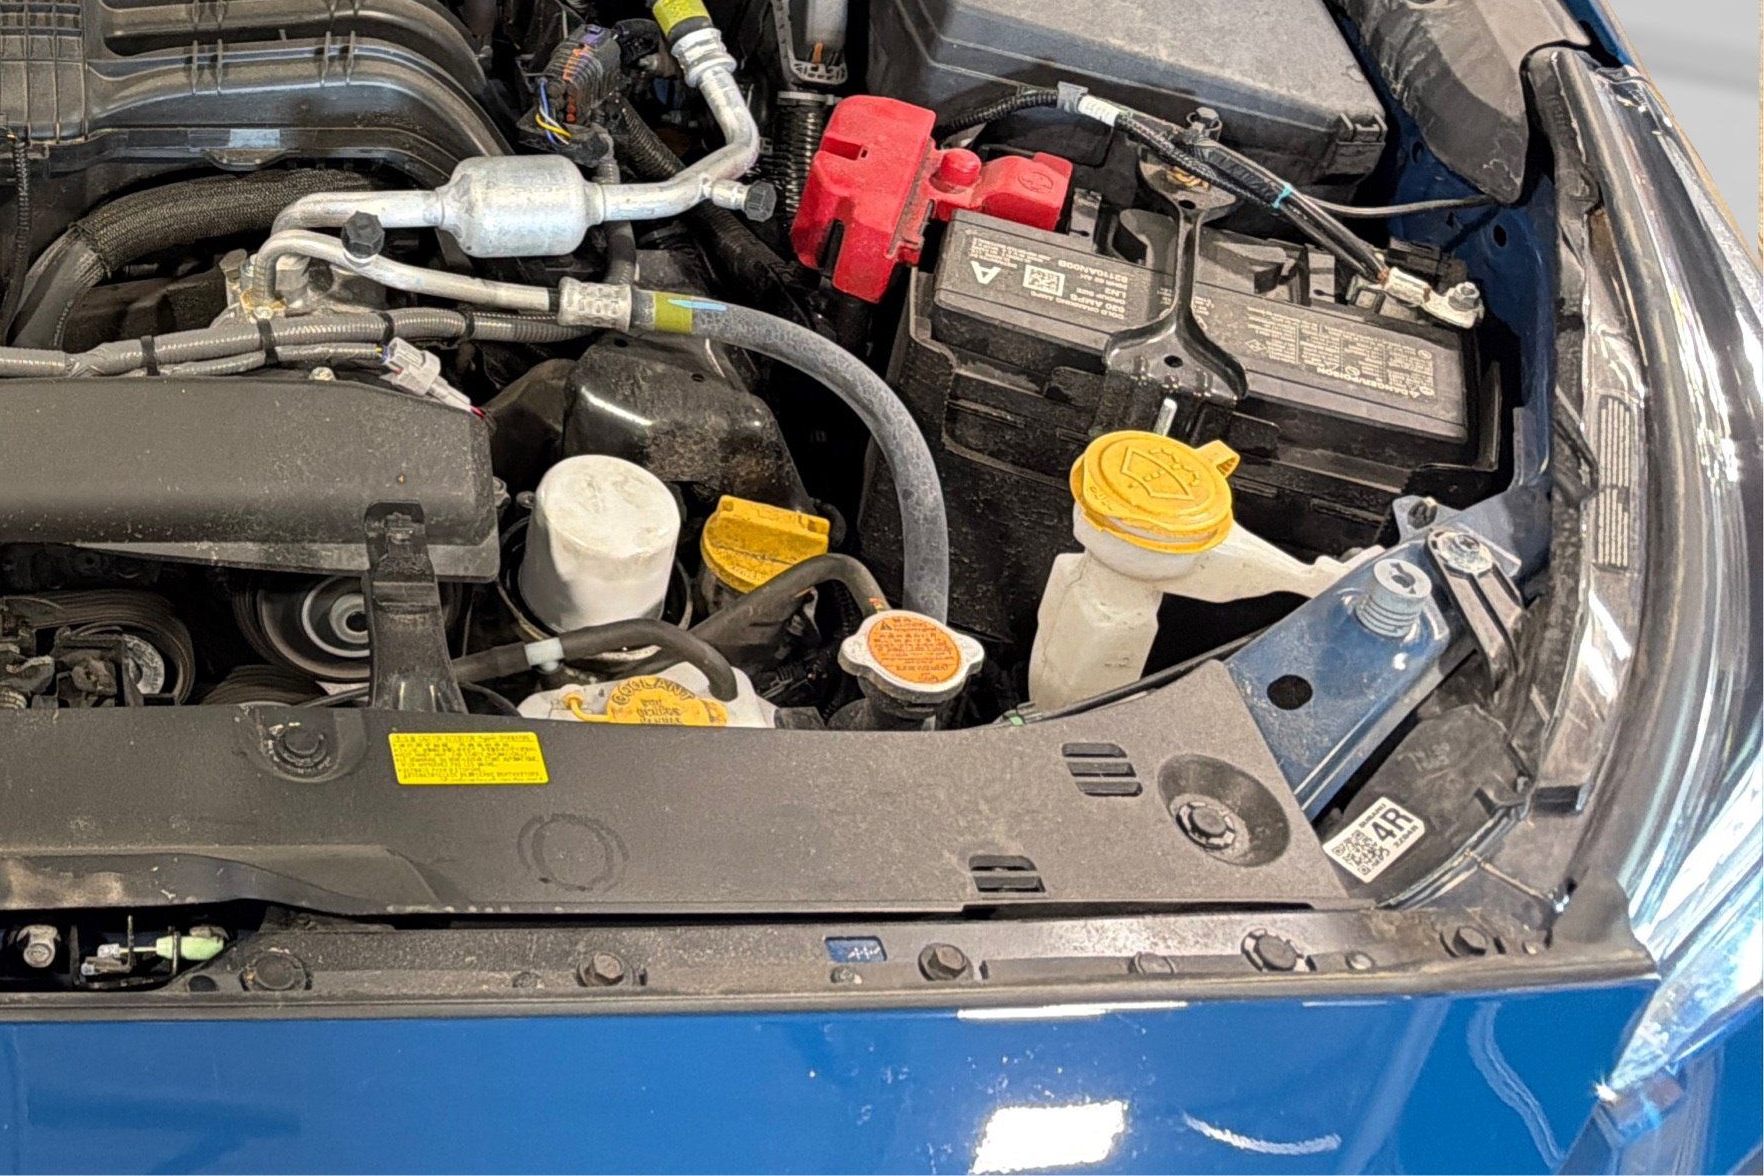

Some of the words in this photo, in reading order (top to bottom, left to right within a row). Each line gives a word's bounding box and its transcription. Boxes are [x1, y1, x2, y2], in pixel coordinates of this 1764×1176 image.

[970, 260, 1002, 284] A
[1070, 293, 1103, 307] AMPS
[1100, 309, 1124, 320] COLD
[611, 677, 695, 706] COOLANT
[1358, 803, 1387, 828] SUBARU
[1371, 807, 1414, 841] 4R
